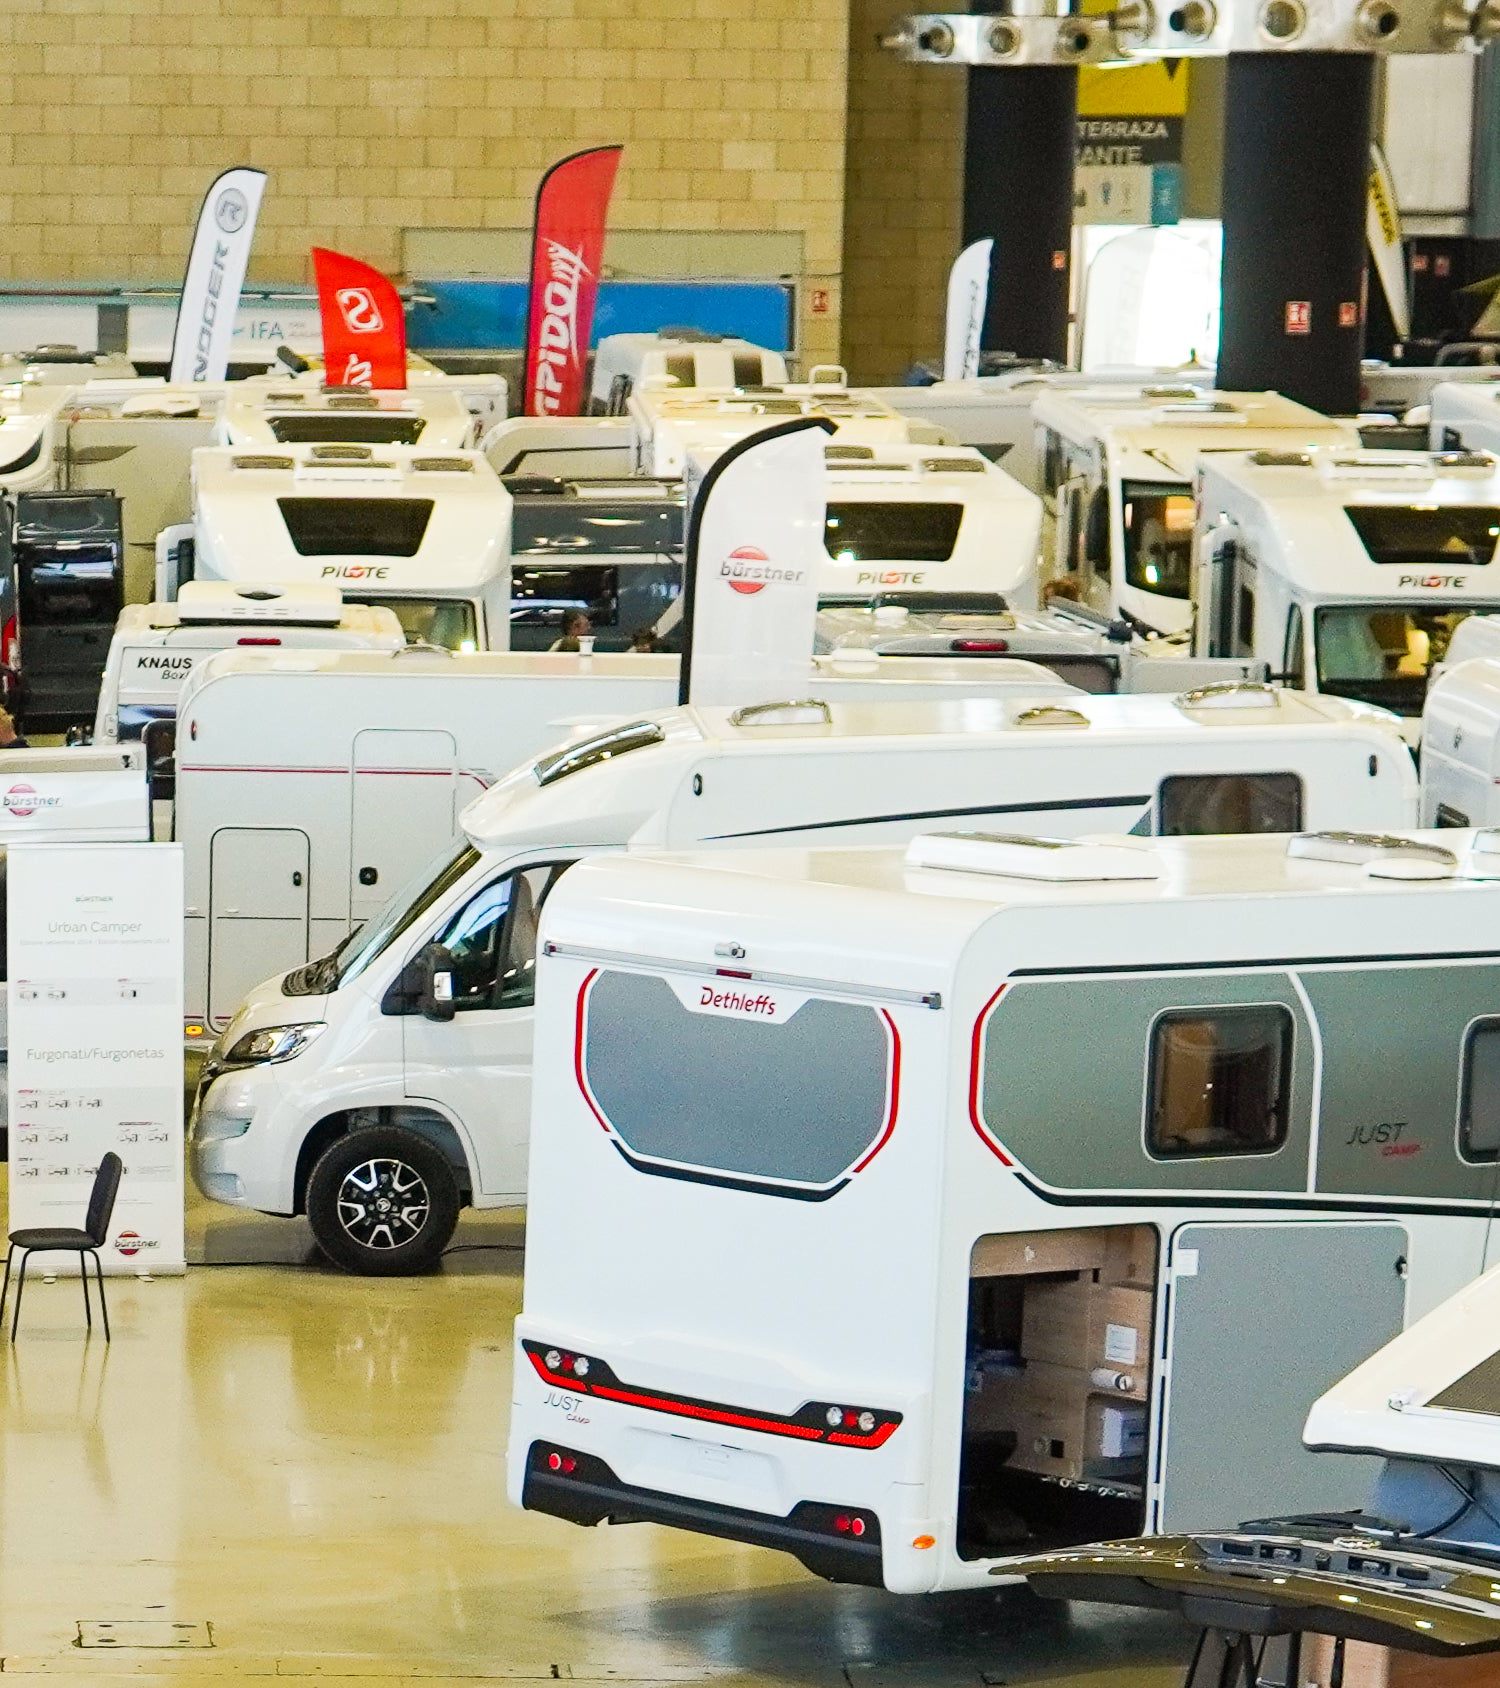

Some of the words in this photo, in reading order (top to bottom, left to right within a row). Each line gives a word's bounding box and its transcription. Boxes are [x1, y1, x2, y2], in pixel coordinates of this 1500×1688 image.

[193, 244, 230, 382] NDGER
[250, 321, 285, 340] IFA
[720, 561, 804, 582] bürstner
[136, 656, 193, 669] KNAUS
[160, 669, 190, 680] Boxl
[2, 794, 62, 807] bürstner
[48, 920, 88, 935] Urban
[91, 920, 144, 937] Camper
[700, 985, 777, 1016] Dethleffs
[26, 1046, 165, 1063] Furgonati/Furgonetas
[1345, 1122, 1408, 1145] JUST
[1381, 1143, 1422, 1157] CAMP
[113, 1238, 158, 1249] bürstner
[543, 1391, 584, 1413] JUST
[565, 1412, 591, 1425] CAMP
